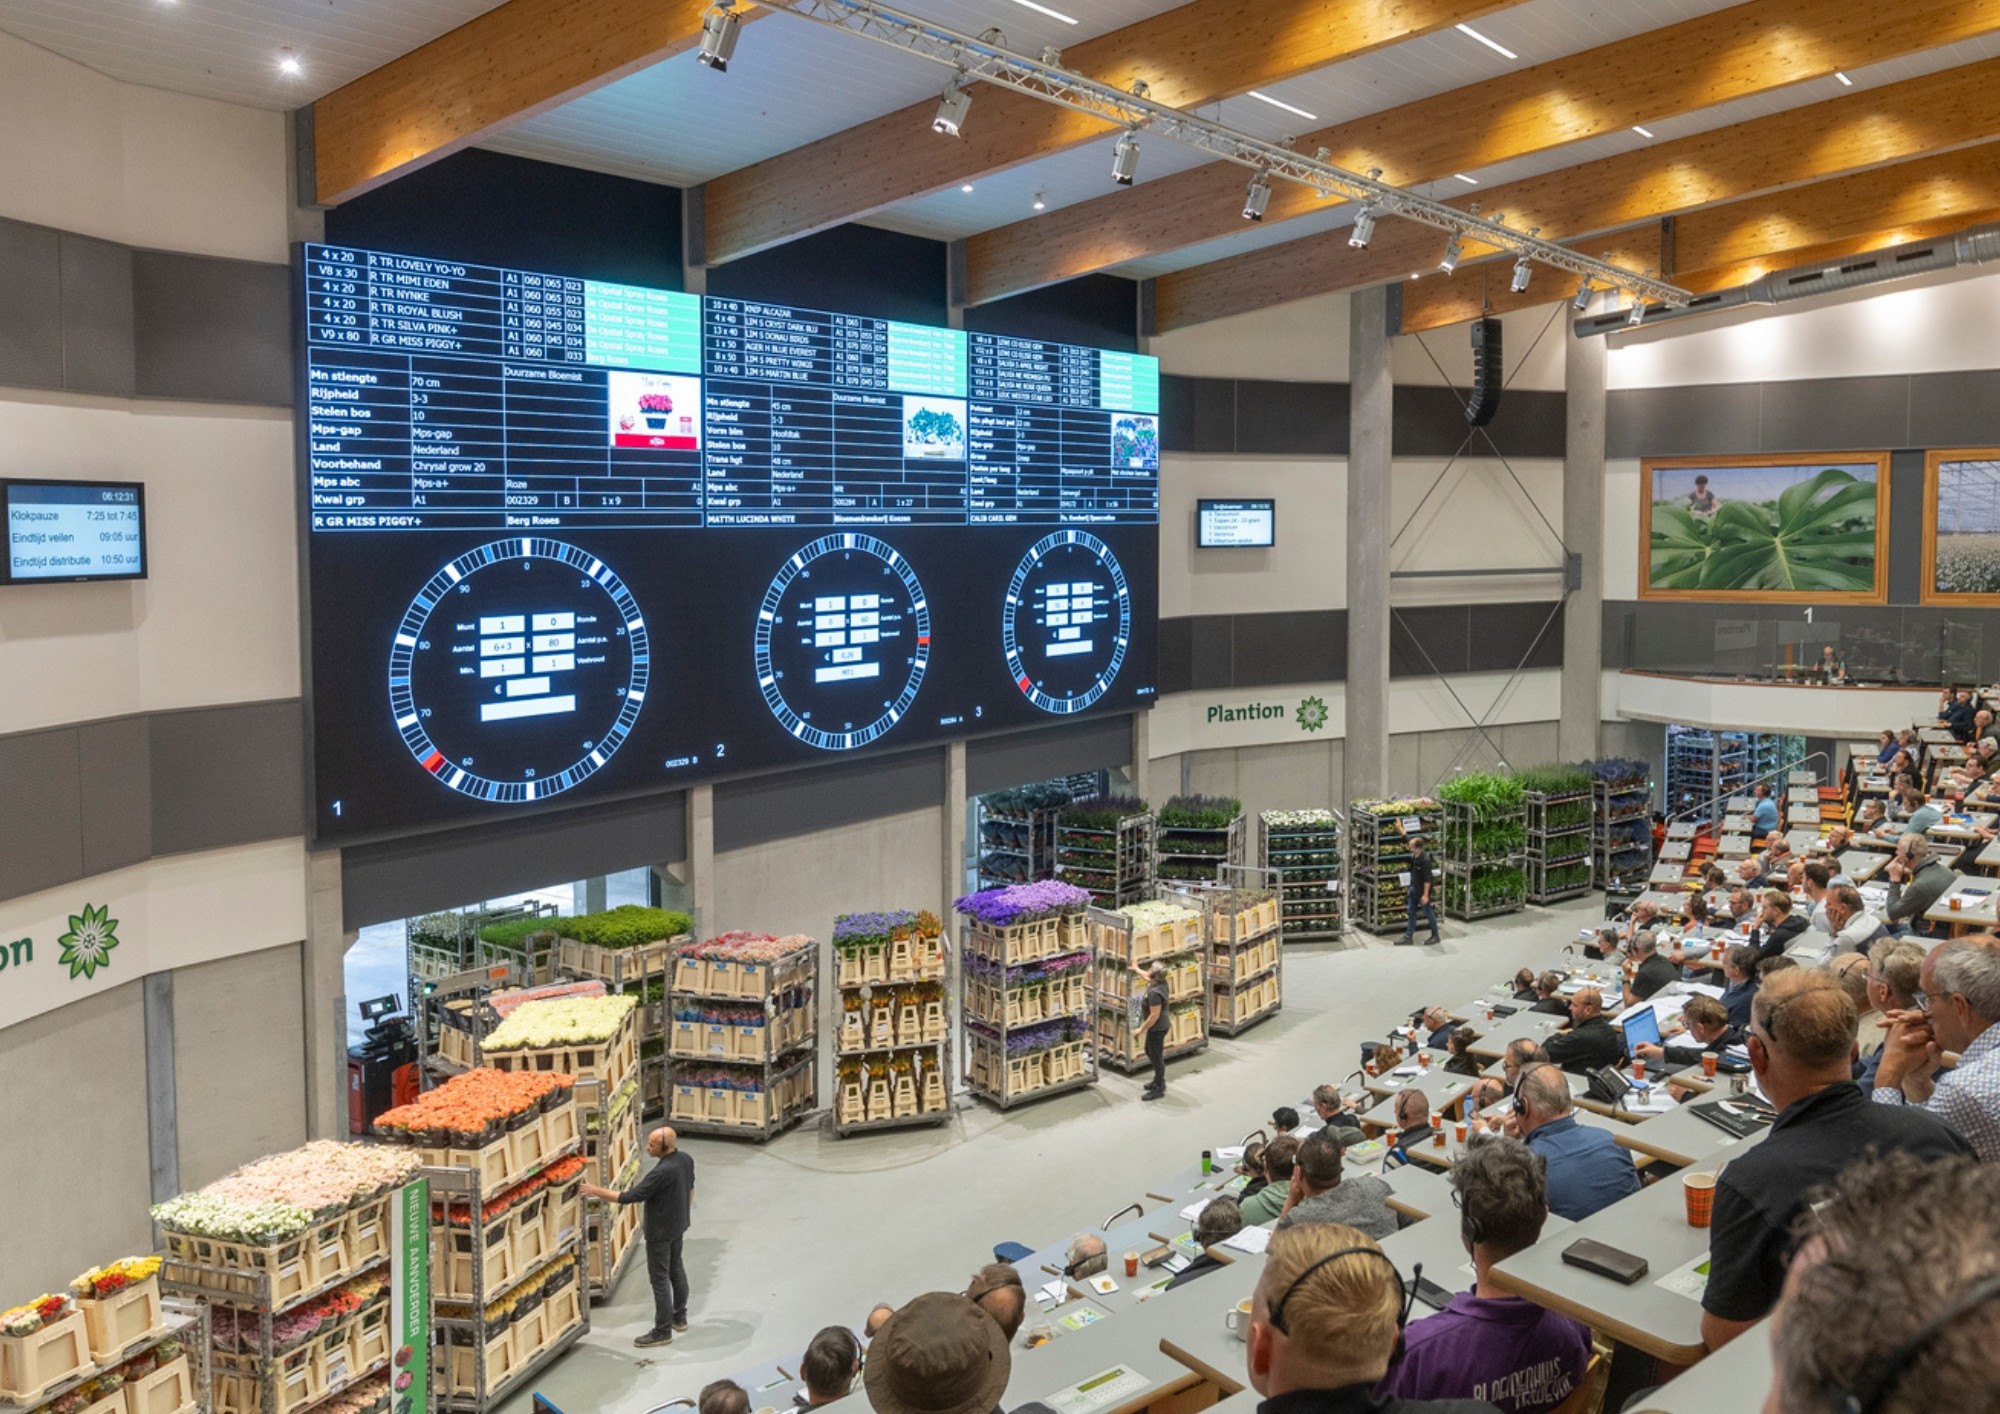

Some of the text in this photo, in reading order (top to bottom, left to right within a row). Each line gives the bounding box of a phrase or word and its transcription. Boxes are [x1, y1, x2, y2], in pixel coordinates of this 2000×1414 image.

[322, 250, 330, 259] 4
[340, 251, 355, 263] 20
[369, 255, 378, 266] R
[380, 257, 394, 268] TR
[395, 258, 433, 272] LOVELY
[434, 263, 466, 276] YO-YO
[506, 273, 518, 284] A1
[524, 275, 541, 287] 060
[545, 278, 561, 289] 065
[566, 281, 582, 291] 023
[318, 265, 333, 275] V8
[344, 268, 358, 279] 30
[370, 271, 378, 281] R
[380, 272, 394, 283] TR
[396, 274, 422, 286] MIMI
[423, 277, 450, 289] EDEN
[546, 292, 561, 303] 065
[566, 295, 582, 306] 023
[323, 281, 330, 291] 4
[341, 283, 355, 294] 20
[370, 286, 378, 297] R
[380, 287, 395, 298] TR
[396, 288, 430, 302] NYNKE
[546, 306, 562, 317] 055
[566, 309, 582, 319] 023
[323, 297, 582, 333] 4 x 20 R TR ROYAL BLUSH 045 034
[323, 313, 331, 322] 4
[343, 315, 356, 326] 20
[371, 317, 379, 327] R
[382, 318, 395, 329] TR
[397, 319, 426, 332] SILVA
[428, 322, 458, 335] PINK+
[547, 334, 563, 345] 045
[567, 336, 583, 347] 034
[320, 329, 335, 340] V9
[345, 330, 360, 342] 80
[371, 333, 379, 343] R
[381, 333, 396, 345] GR
[399, 335, 423, 347] MISS
[425, 337, 462, 350] PIGGY+
[508, 345, 520, 355] A1
[526, 347, 542, 358] 060
[567, 350, 583, 361] 033
[311, 370, 440, 388] Mn stlengte 70 cm
[504, 366, 583, 382] Duurzame Bloemist
[311, 388, 429, 404] Rijpheid 3-3
[311, 406, 425, 420] Stelen bos 10
[312, 424, 452, 440] Mps-gap Mps-gap
[313, 442, 460, 456] Land Nederland
[312, 459, 486, 473] Voorbehand Chrysal grow 20
[314, 476, 527, 489] Mps abc Mps-a+ Roze
[314, 495, 538, 507] Kwal grp A1 002329
[11, 510, 137, 522] Klokpauze 7:25 tot 7:45
[315, 515, 560, 526] R GR MISS PIGGY+ Berg Roses
[12, 532, 138, 544] Eindtijd veilen 09:05 uur
[13, 557, 47, 569] Eindtijd
[50, 555, 91, 566] distributie
[101, 555, 124, 564] 10:50
[524, 562, 530, 571] 0
[459, 585, 470, 594] 90
[581, 579, 590, 588] 10
[1803, 607, 1813, 624] 1
[457, 623, 475, 631] Munt
[500, 621, 505, 630] 1
[550, 617, 557, 626] 0
[616, 627, 625, 636] 20
[419, 641, 431, 650] 80
[616, 687, 626, 696] 30
[420, 708, 432, 717] 70
[975, 705, 982, 718] 3
[1207, 703, 1284, 724] Plantion
[582, 741, 592, 750] 40
[716, 743, 725, 757] 2
[462, 758, 474, 767] 60
[525, 769, 535, 778] 50
[333, 800, 341, 816] 1
[409, 1189, 420, 1338] NIEUWE AANVOERDER
